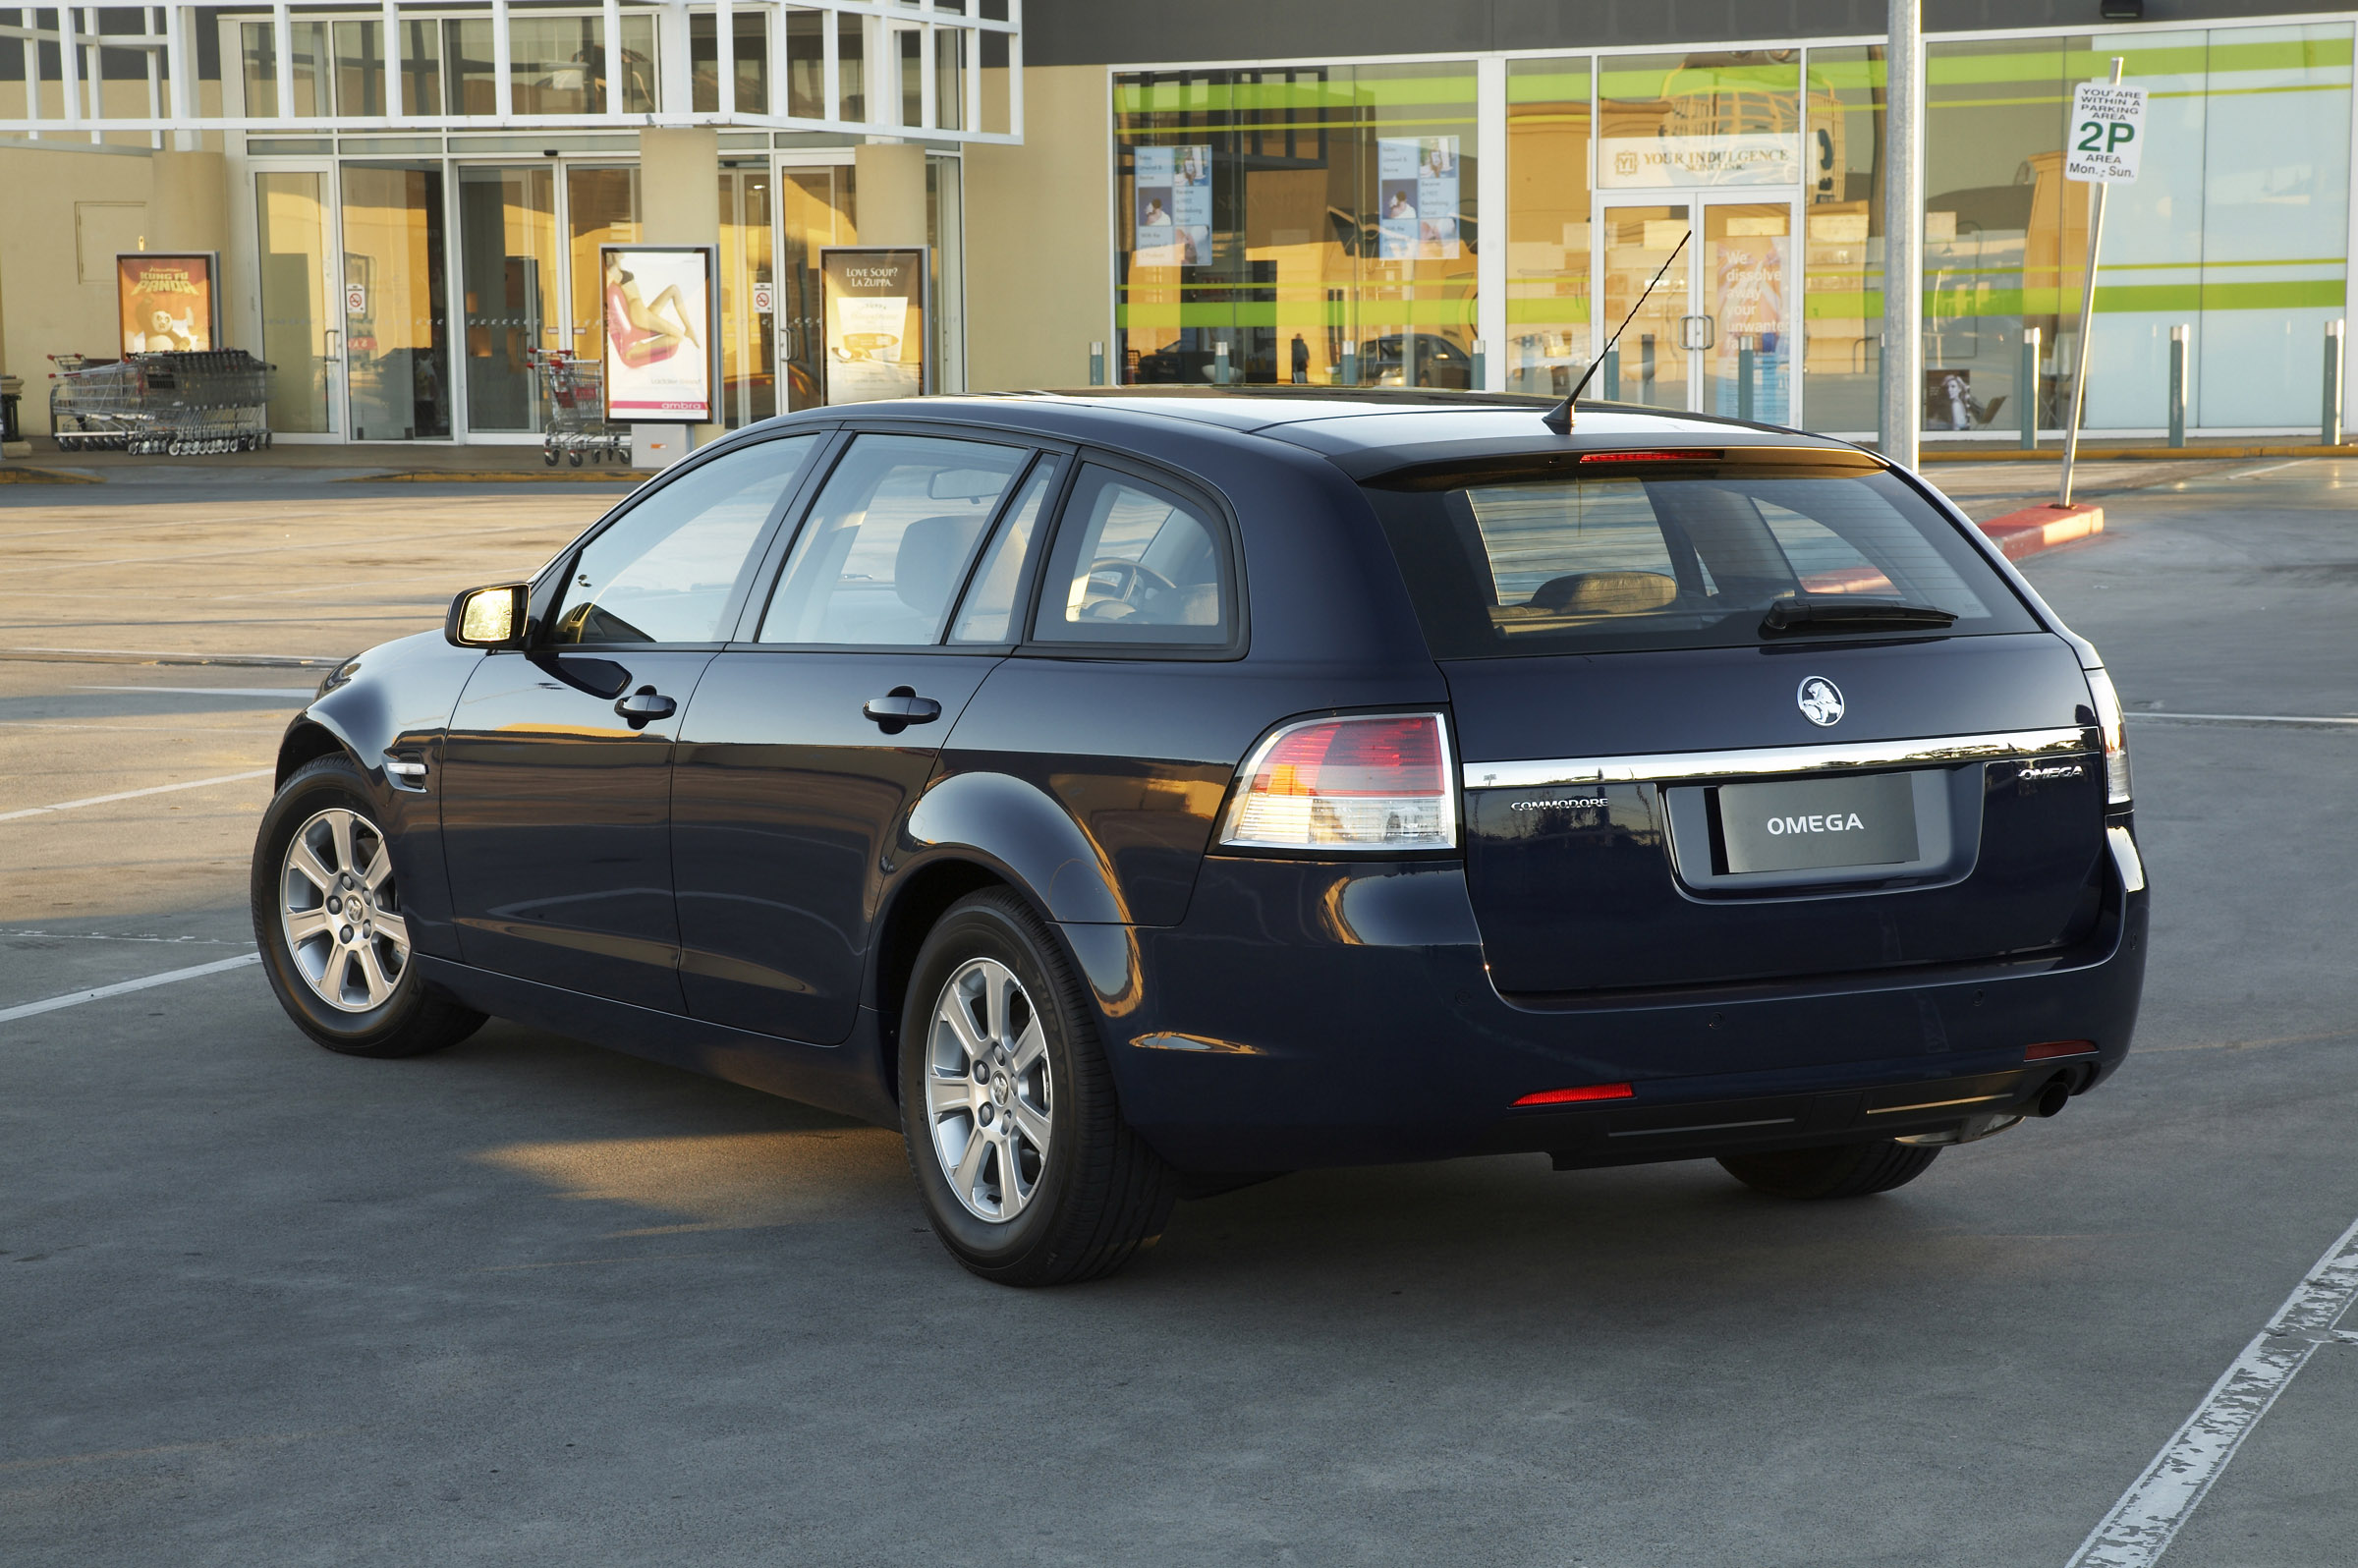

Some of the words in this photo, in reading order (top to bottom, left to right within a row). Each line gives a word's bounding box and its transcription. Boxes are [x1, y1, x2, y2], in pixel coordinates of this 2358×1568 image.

[2081, 96, 2127, 105] WITHIN
[2081, 104, 2139, 115] PARKING
[2092, 112, 2127, 121] AREA
[2077, 121, 2135, 153] 2P
[1644, 152, 1684, 165] YOUR
[1689, 149, 1789, 164] INDULGENCE
[2085, 153, 2122, 164] AREA
[1726, 251, 1748, 264] We
[140, 271, 172, 280] KUNG
[175, 271, 189, 280] FU
[846, 267, 869, 277] LOVE
[870, 266, 898, 277] SOUP?
[1726, 268, 1782, 282] dissolve
[130, 280, 199, 297] PANDA
[851, 278, 863, 287] LA
[1726, 288, 1762, 302] away
[1726, 306, 1757, 319] your
[2017, 765, 2084, 780] OMEGA
[1510, 798, 1609, 812] COMMODORE
[1767, 812, 1865, 835] OMEGA
